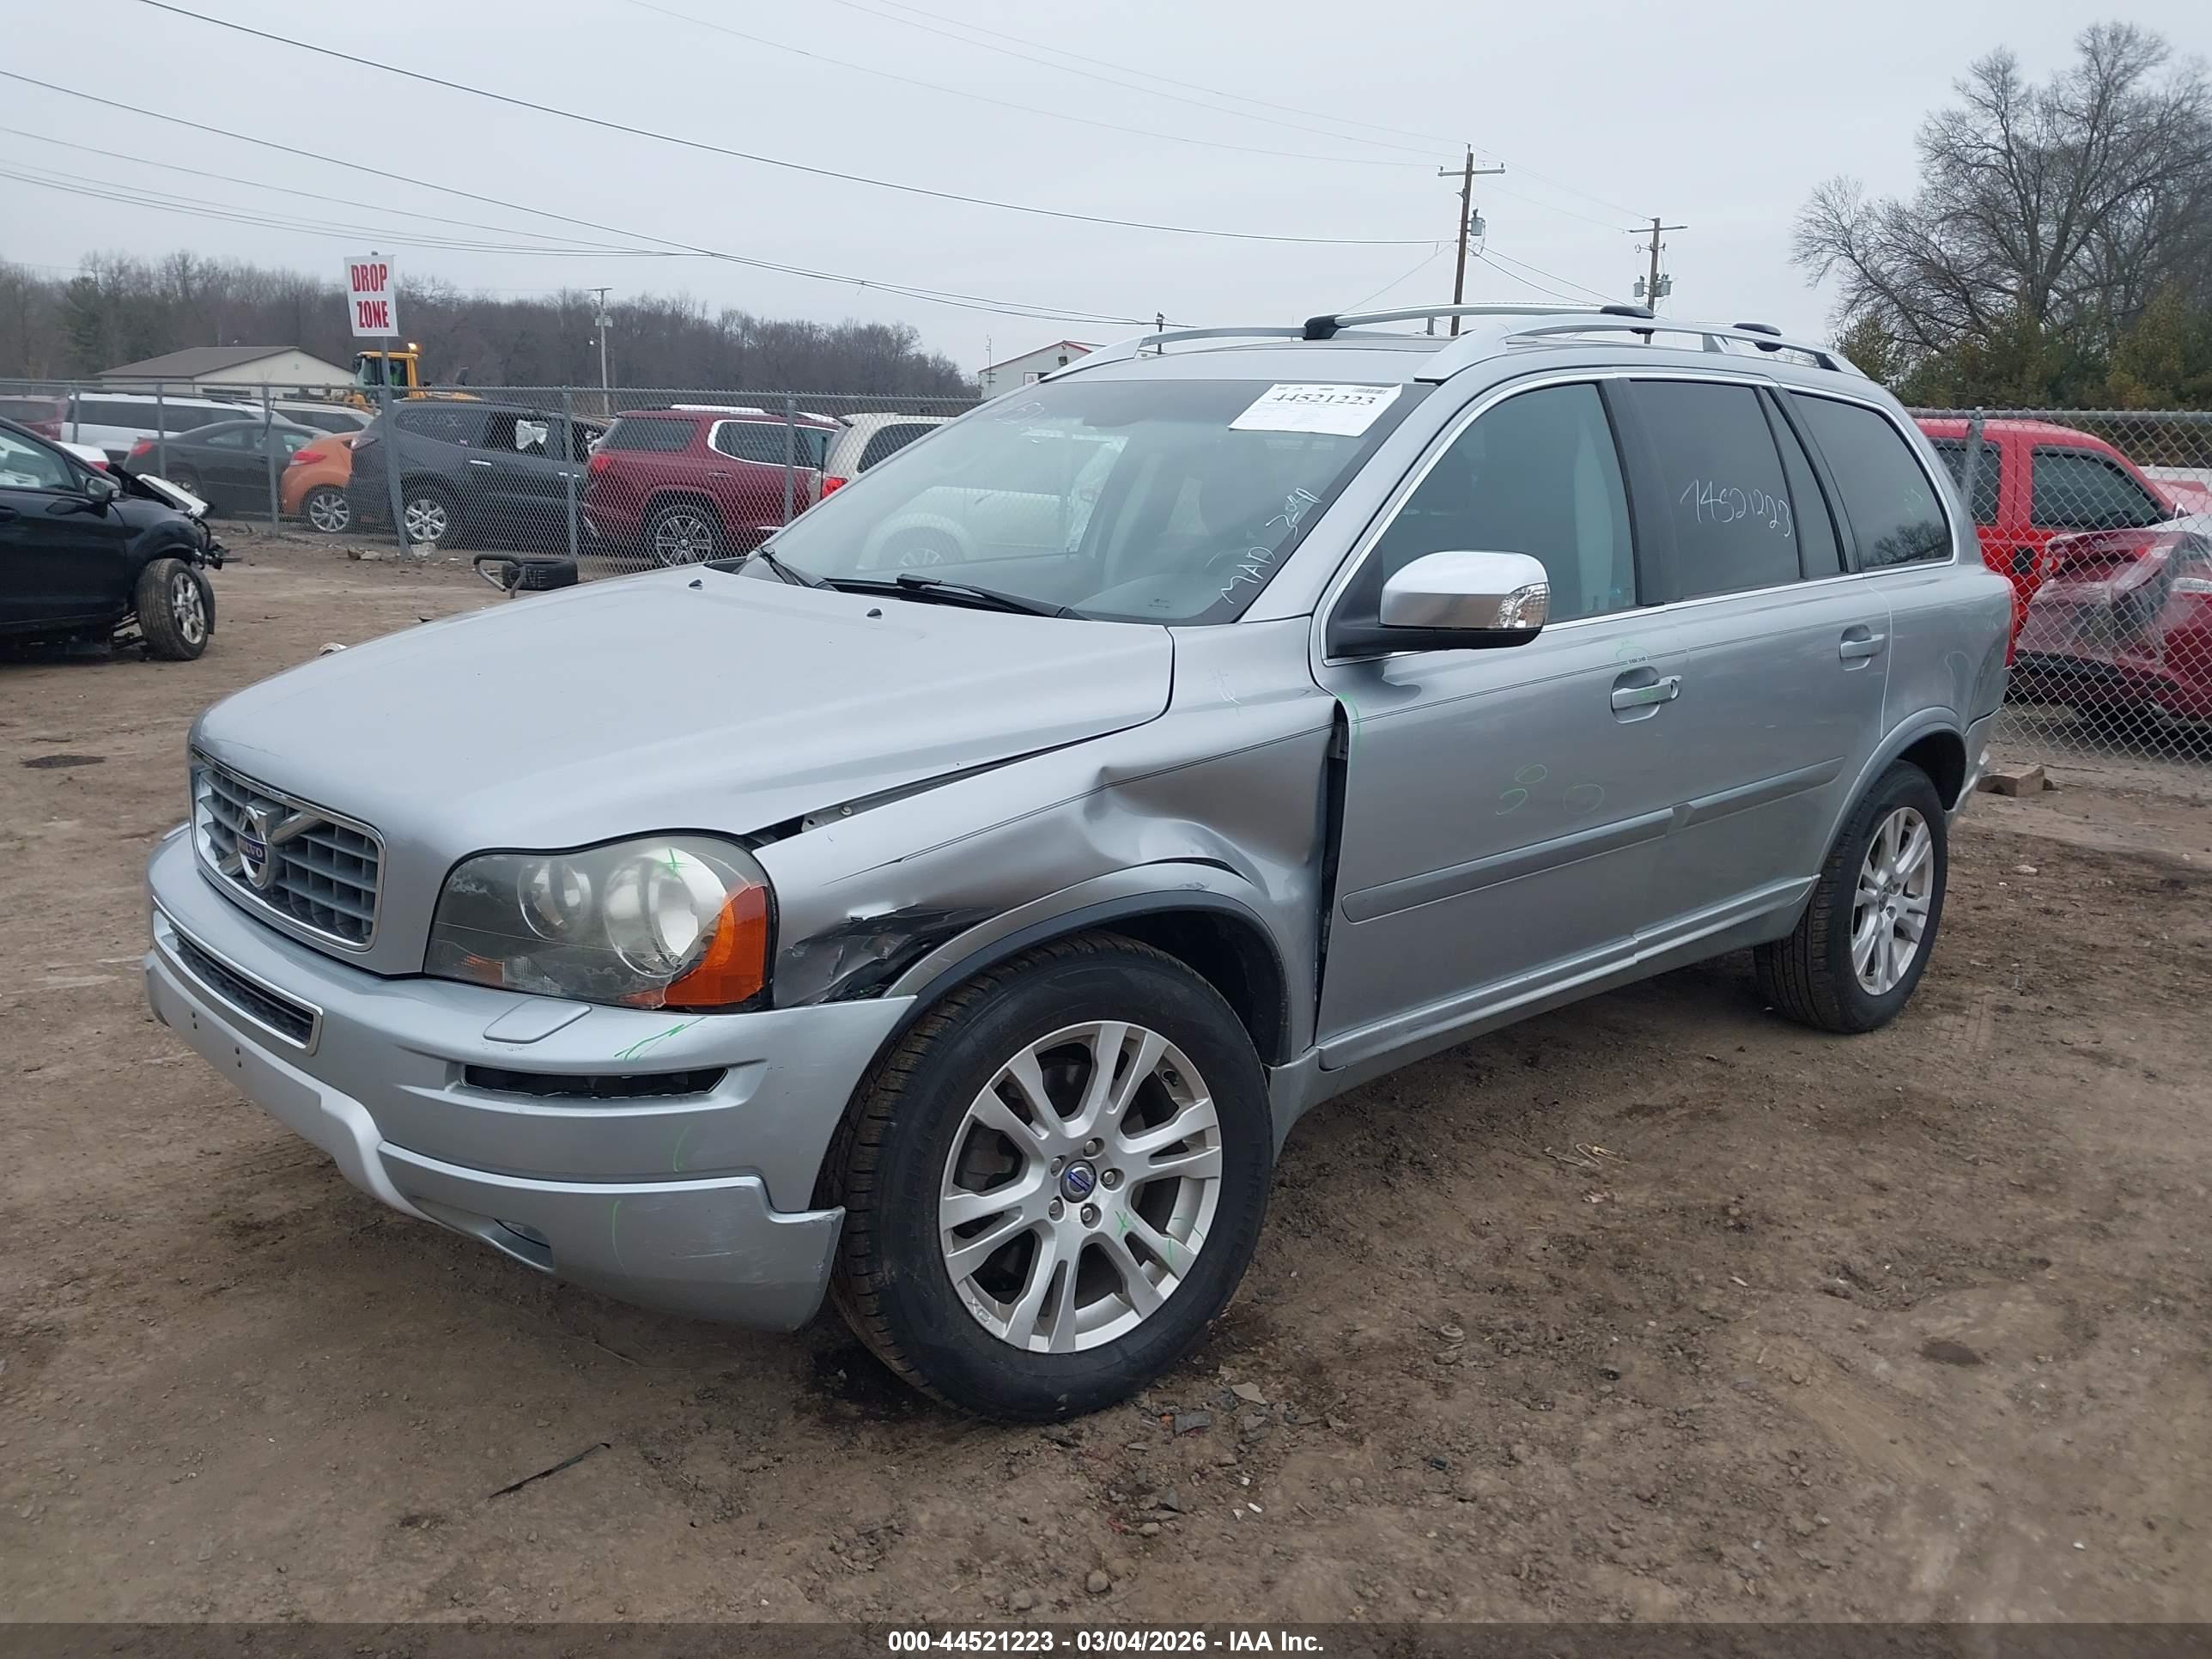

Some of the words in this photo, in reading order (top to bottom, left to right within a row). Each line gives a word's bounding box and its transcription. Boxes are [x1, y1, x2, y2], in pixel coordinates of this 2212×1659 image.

[350, 264, 387, 292] DROP
[356, 301, 390, 328] ZONE
[1272, 392, 1376, 406] 44521223
[1220, 546, 1276, 605] MAD
